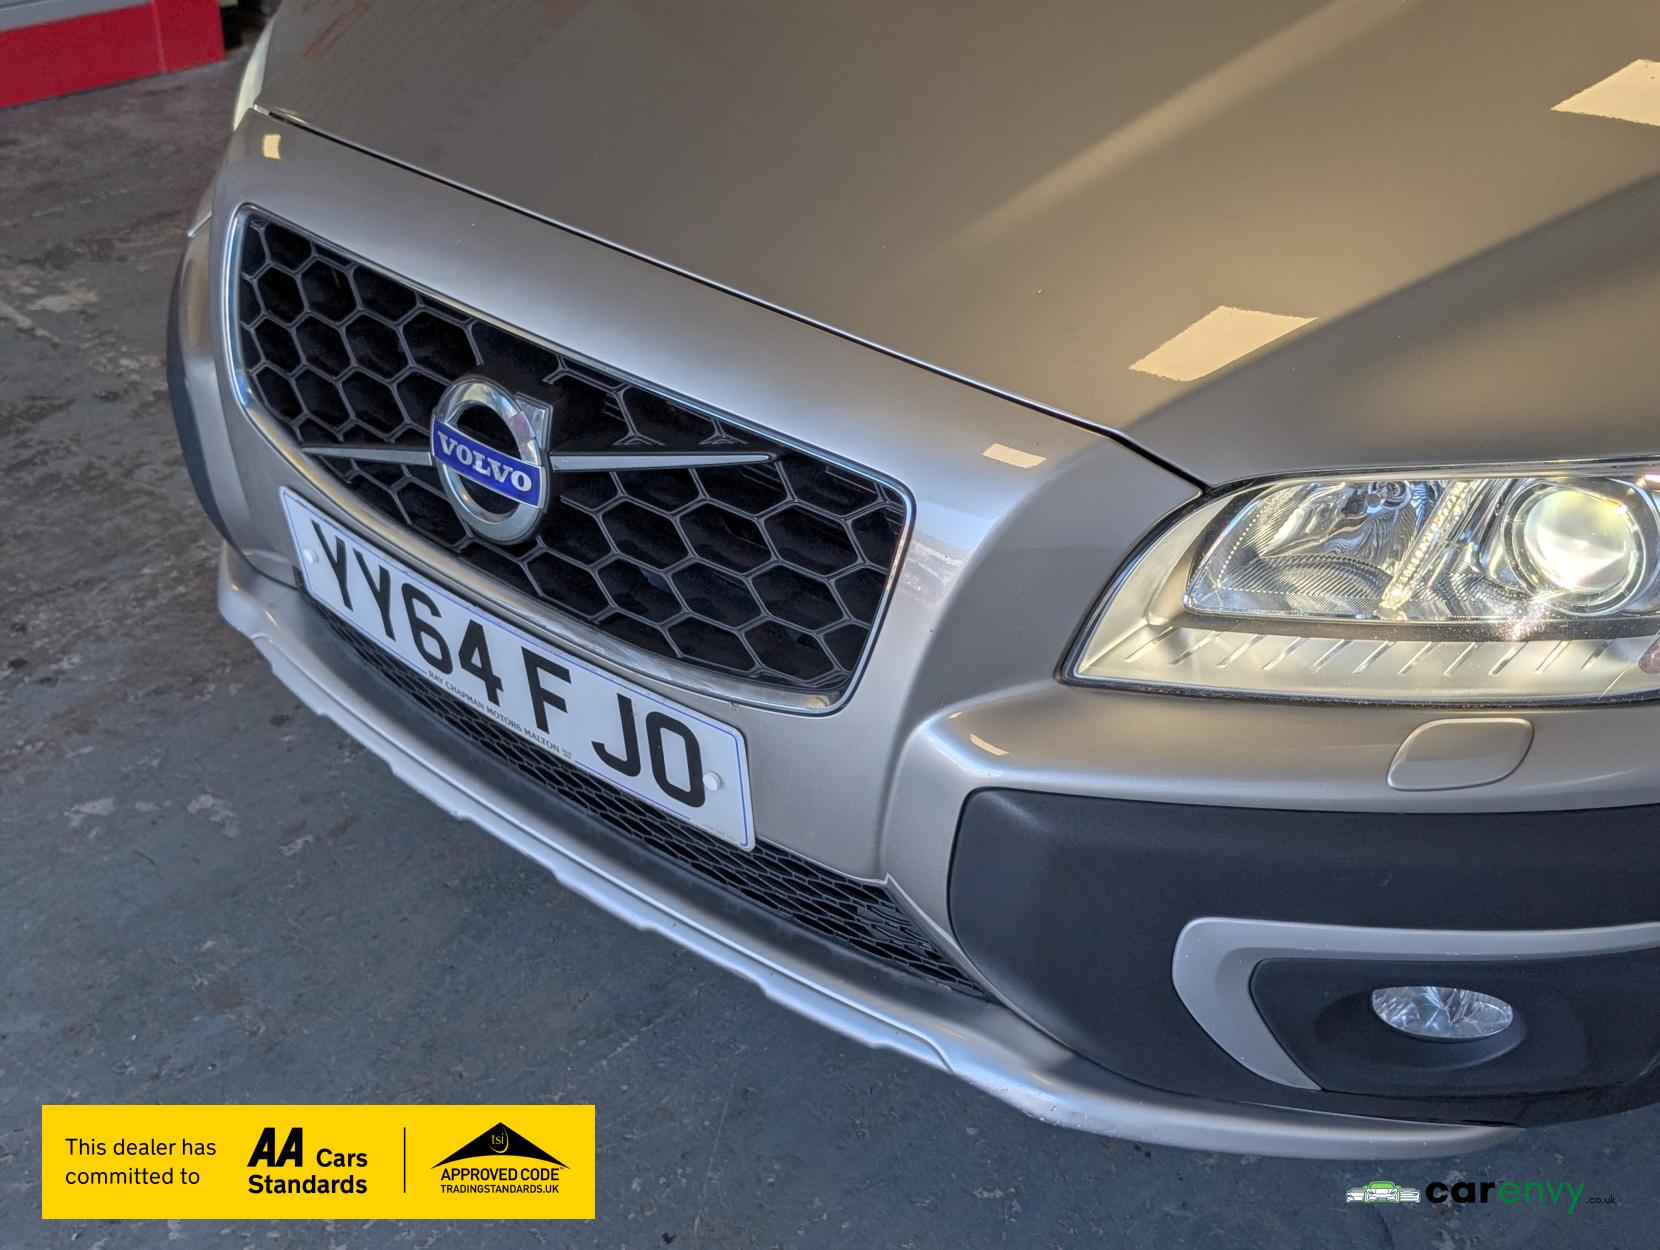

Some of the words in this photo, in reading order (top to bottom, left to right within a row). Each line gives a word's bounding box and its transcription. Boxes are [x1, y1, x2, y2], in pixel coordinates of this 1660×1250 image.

[437, 431, 533, 492] VOLVO
[312, 519, 504, 708] YY64
[521, 646, 706, 808] FJO
[445, 680, 485, 711] CHAPMAN
[486, 706, 523, 733] MOTORS
[523, 728, 560, 754] MALTON
